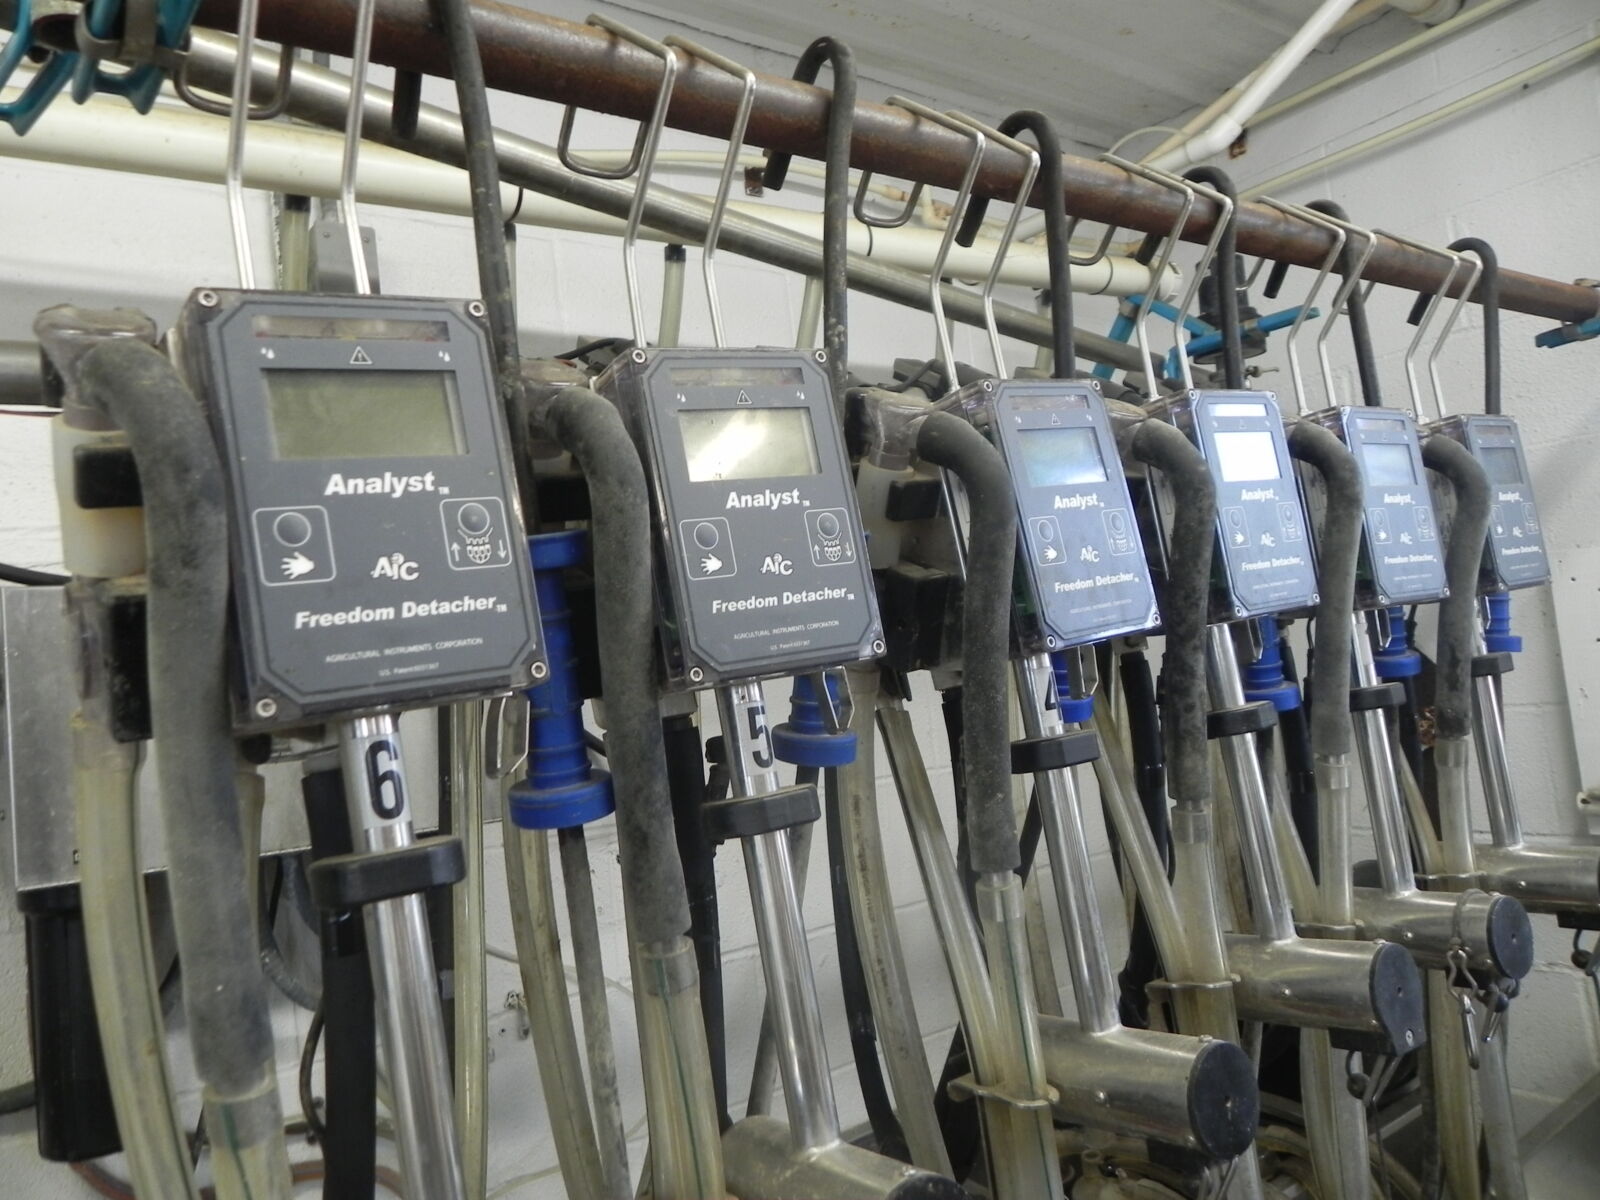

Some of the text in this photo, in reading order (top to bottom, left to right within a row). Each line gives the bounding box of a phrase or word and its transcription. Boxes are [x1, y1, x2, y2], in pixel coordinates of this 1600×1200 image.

[323, 471, 435, 497] Analyst
[1241, 488, 1275, 502] Analyst
[725, 488, 800, 511] Analyst
[1053, 493, 1099, 510] Analyst
[1054, 572, 1135, 594] Freedom Detacher
[294, 605, 395, 629] Freedom
[401, 595, 497, 618] Detacher
[712, 596, 778, 614] Freedom
[782, 586, 847, 605] Detacher
[325, 637, 484, 663] AGRICULTURAL INSTRUMENTS CORPORATION
[747, 705, 774, 768] 5
[365, 739, 404, 820] 6
